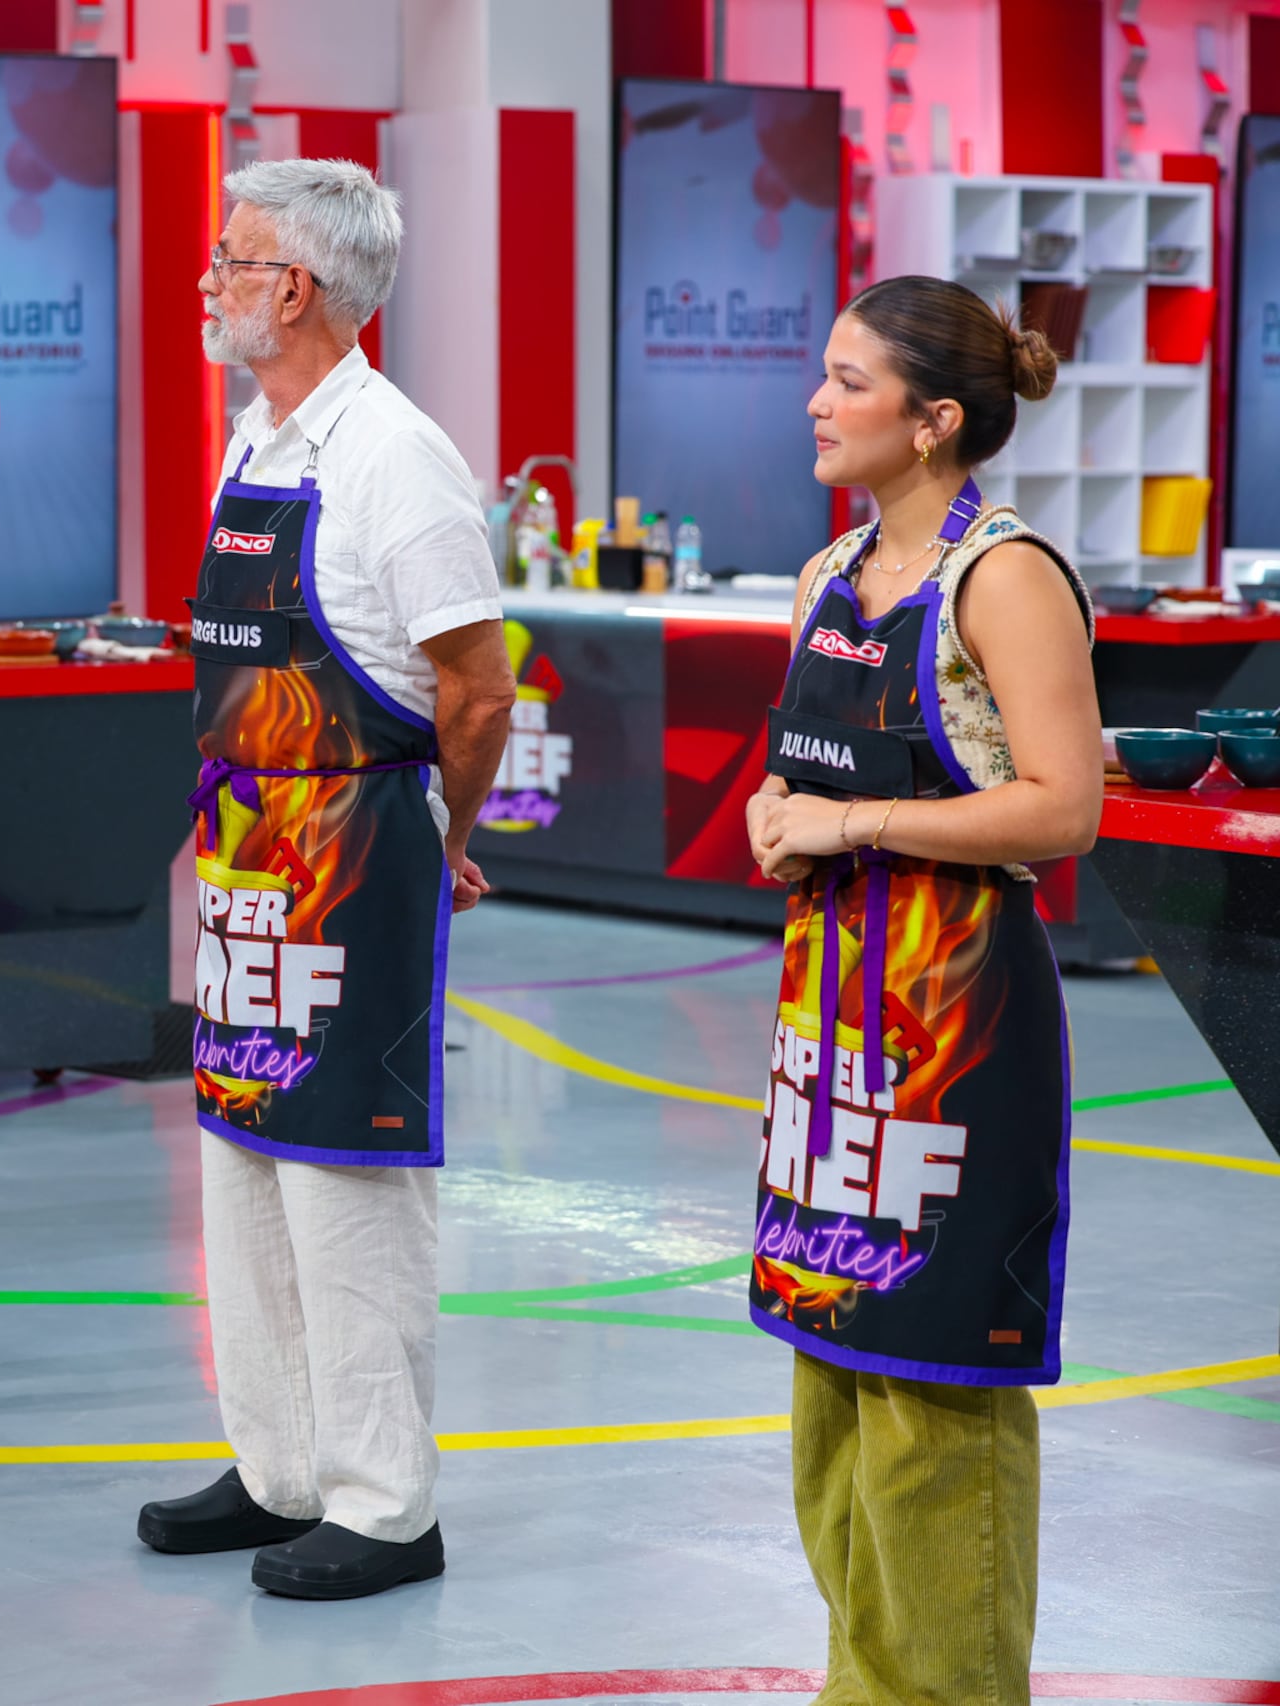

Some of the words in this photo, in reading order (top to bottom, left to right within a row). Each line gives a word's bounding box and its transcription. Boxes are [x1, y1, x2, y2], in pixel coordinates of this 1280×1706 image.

[727, 288, 810, 340] Guard
[214, 531, 271, 551] ONO
[219, 623, 262, 648] LUIS
[779, 731, 856, 772] JULIANA
[197, 878, 288, 938] PER
[195, 928, 346, 1038] HEF
[755, 1194, 923, 1291] lebrities
